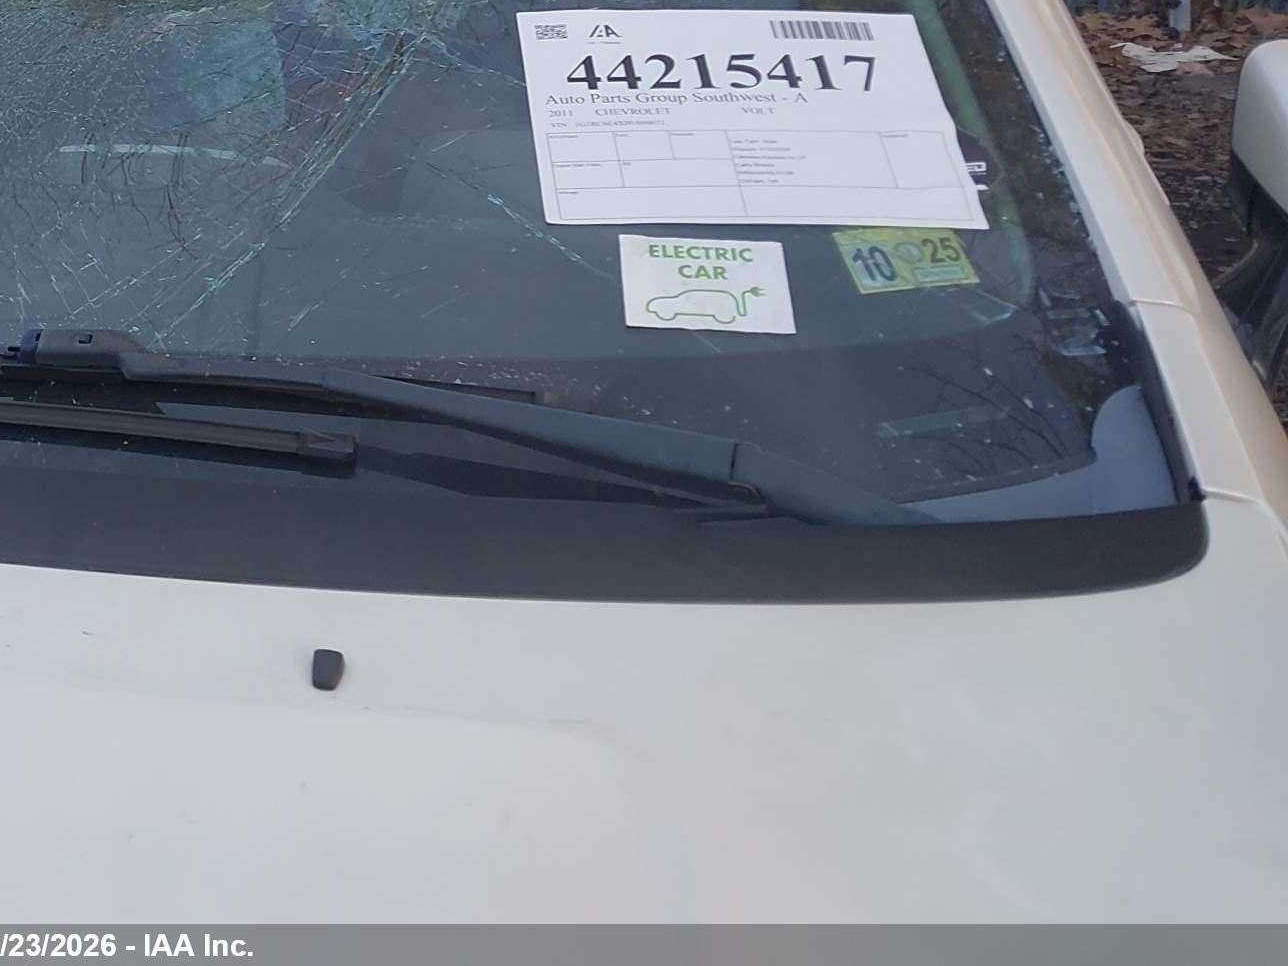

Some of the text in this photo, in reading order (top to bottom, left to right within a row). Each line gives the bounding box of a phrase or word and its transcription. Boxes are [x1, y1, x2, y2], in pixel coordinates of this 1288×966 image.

[567, 53, 876, 92] 44215417
[545, 95, 585, 105] Auto
[591, 93, 631, 104] Parts
[635, 92, 688, 105] Group
[692, 92, 777, 104] Southwest
[794, 92, 809, 104] A
[548, 106, 775, 118] 2011 CHEVROLET VOLT
[648, 244, 754, 262] ELECTRIC
[852, 237, 961, 282] 10 25
[678, 264, 729, 280] CAR
